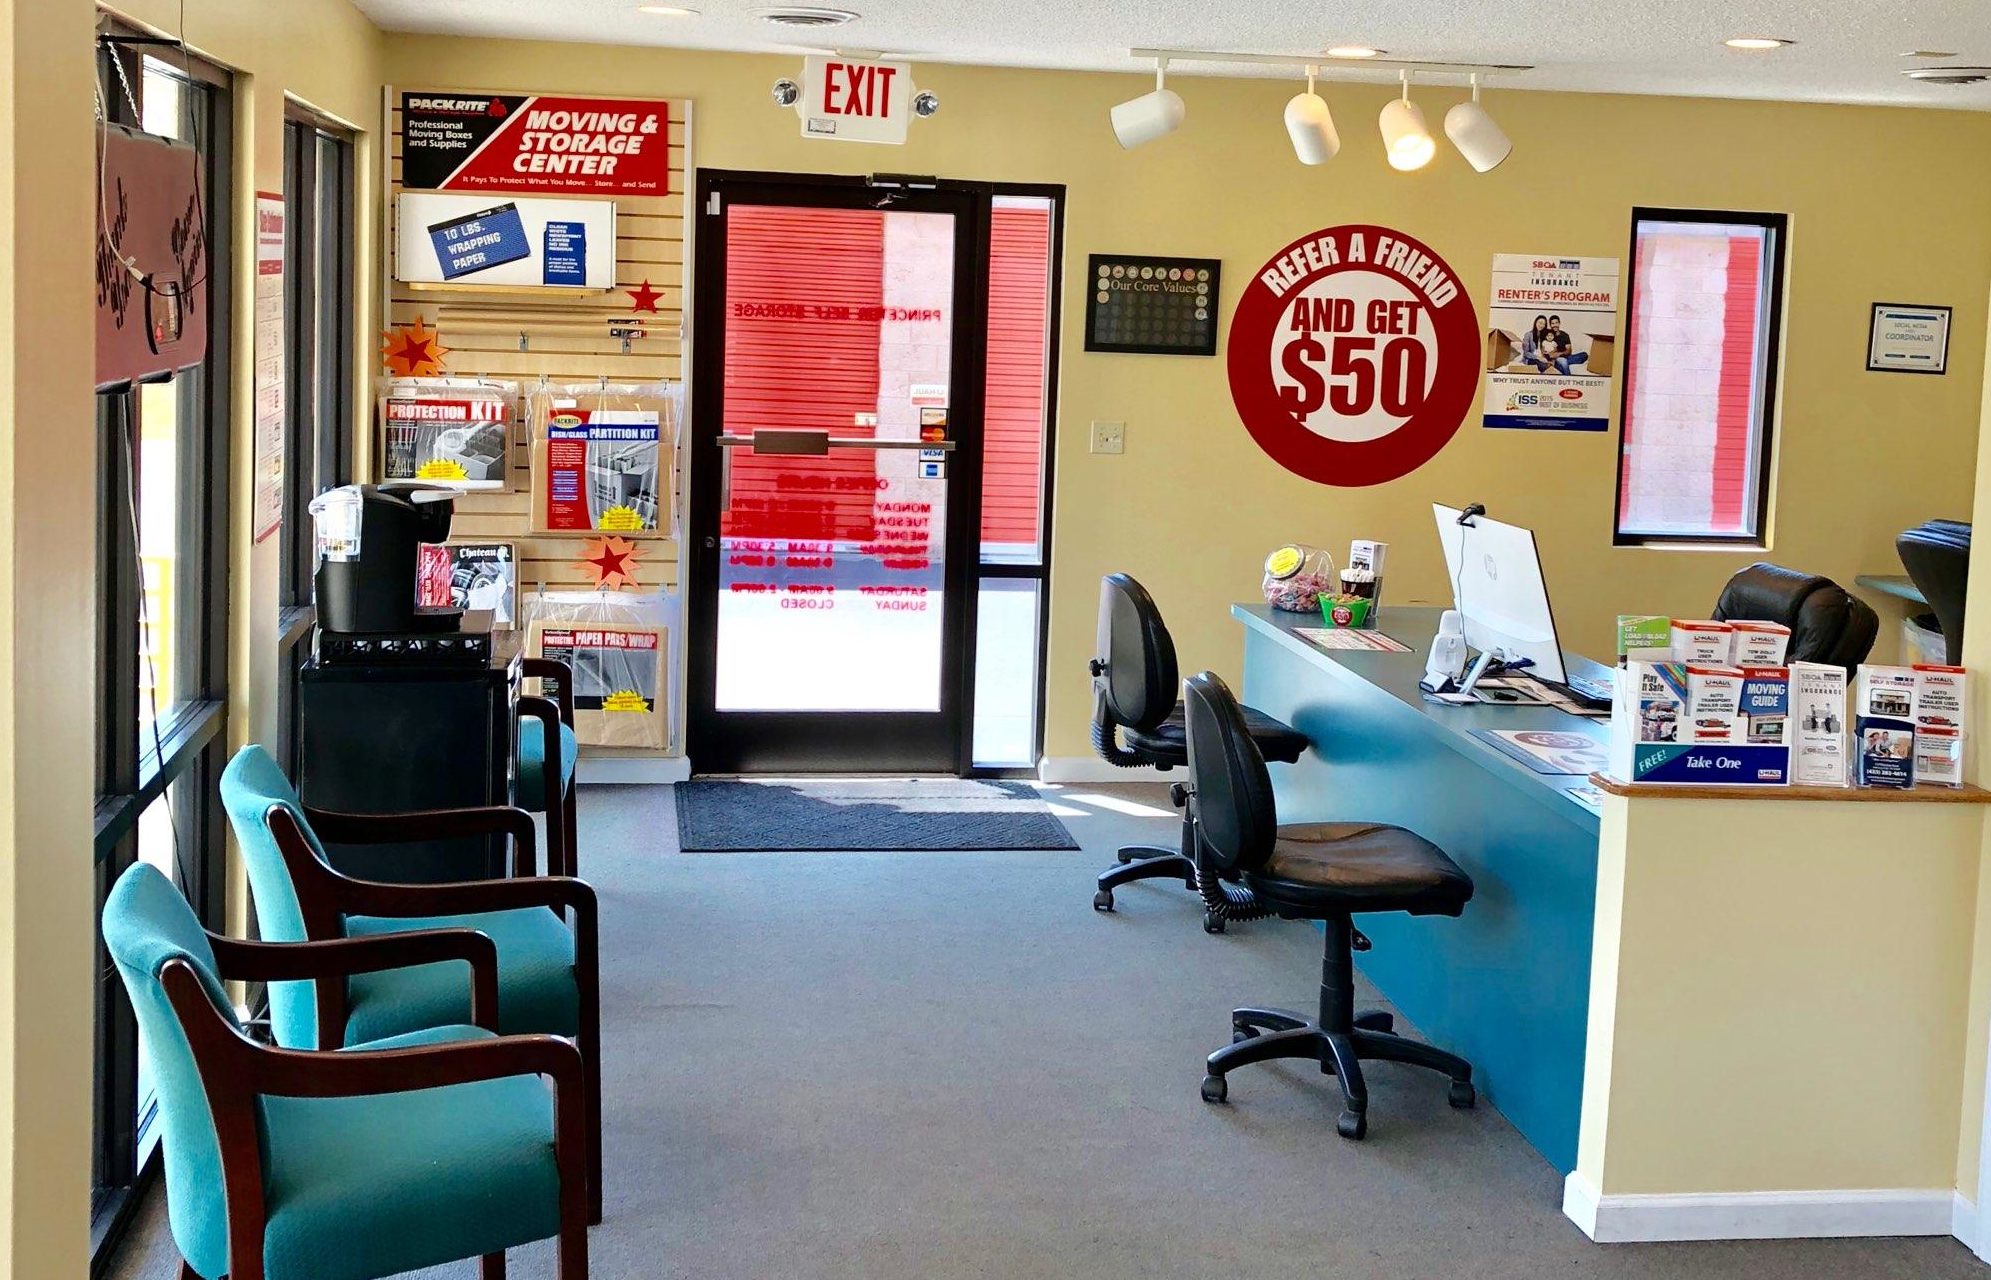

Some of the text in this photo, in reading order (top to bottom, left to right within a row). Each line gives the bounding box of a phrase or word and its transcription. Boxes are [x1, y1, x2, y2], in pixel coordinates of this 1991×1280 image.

[824, 63, 896, 118] EXIT
[409, 120, 463, 130] Professional
[525, 110, 658, 134] MOVING &
[409, 129, 473, 140] Moving Boxes
[409, 139, 467, 150] and Supplies
[519, 132, 644, 155] STORAGE
[513, 153, 618, 175] CENTER
[471, 176, 488, 185] Pays
[500, 177, 526, 185] Protect
[550, 178, 564, 186] You
[622, 180, 637, 188] and
[638, 181, 656, 189] Send
[444, 221, 486, 241] 10 LBS.
[447, 232, 501, 255] WRAPPING
[452, 252, 486, 270] PAPER
[1261, 233, 1458, 309] REFER A FRIEND
[1111, 280, 1197, 293] Our Core Values
[1531, 278, 1580, 287] INSURANCE
[1498, 289, 1610, 303] RENTER'S PROGRAM
[1290, 297, 1423, 335] AND GET
[1885, 333, 1934, 342] COORDINATOR
[1280, 332, 1427, 422] $50
[1518, 395, 1538, 405] ISS
[389, 401, 505, 421] PROTECTION KIT
[551, 428, 656, 439] DISH/GLASS PARTITION KIT
[923, 449, 943, 457] VISA
[459, 547, 497, 559] Chateau
[575, 631, 603, 646] PAPER
[1643, 673, 1658, 684] Play
[1642, 683, 1664, 692] It Safe
[1747, 683, 1785, 695] MOVING
[1752, 696, 1779, 707] GUIDE
[1639, 749, 1667, 772] FREE!
[1686, 755, 1742, 769] Take One
[1758, 769, 1781, 777] U-HAUL
